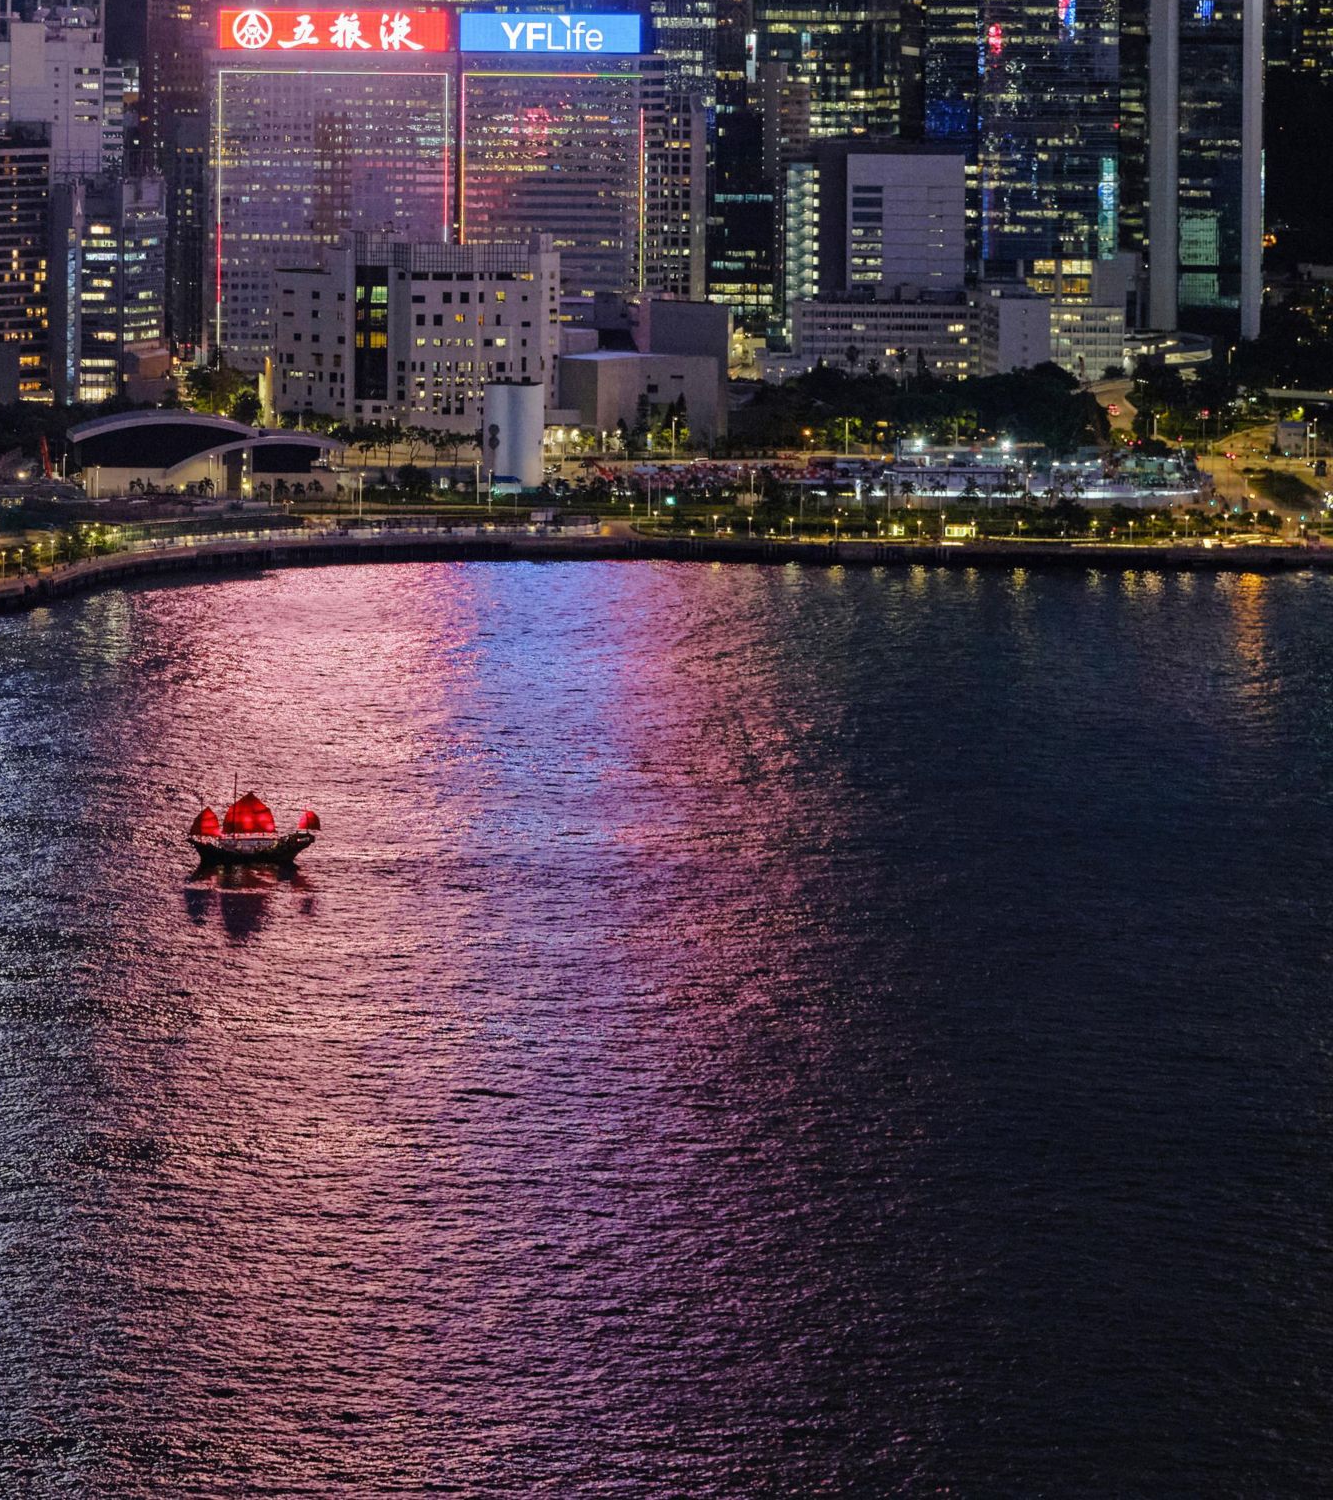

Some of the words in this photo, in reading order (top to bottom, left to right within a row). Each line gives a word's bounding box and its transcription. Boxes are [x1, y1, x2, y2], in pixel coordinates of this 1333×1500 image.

[277, 11, 425, 51] 五粮液
[500, 15, 604, 51] YFLife
